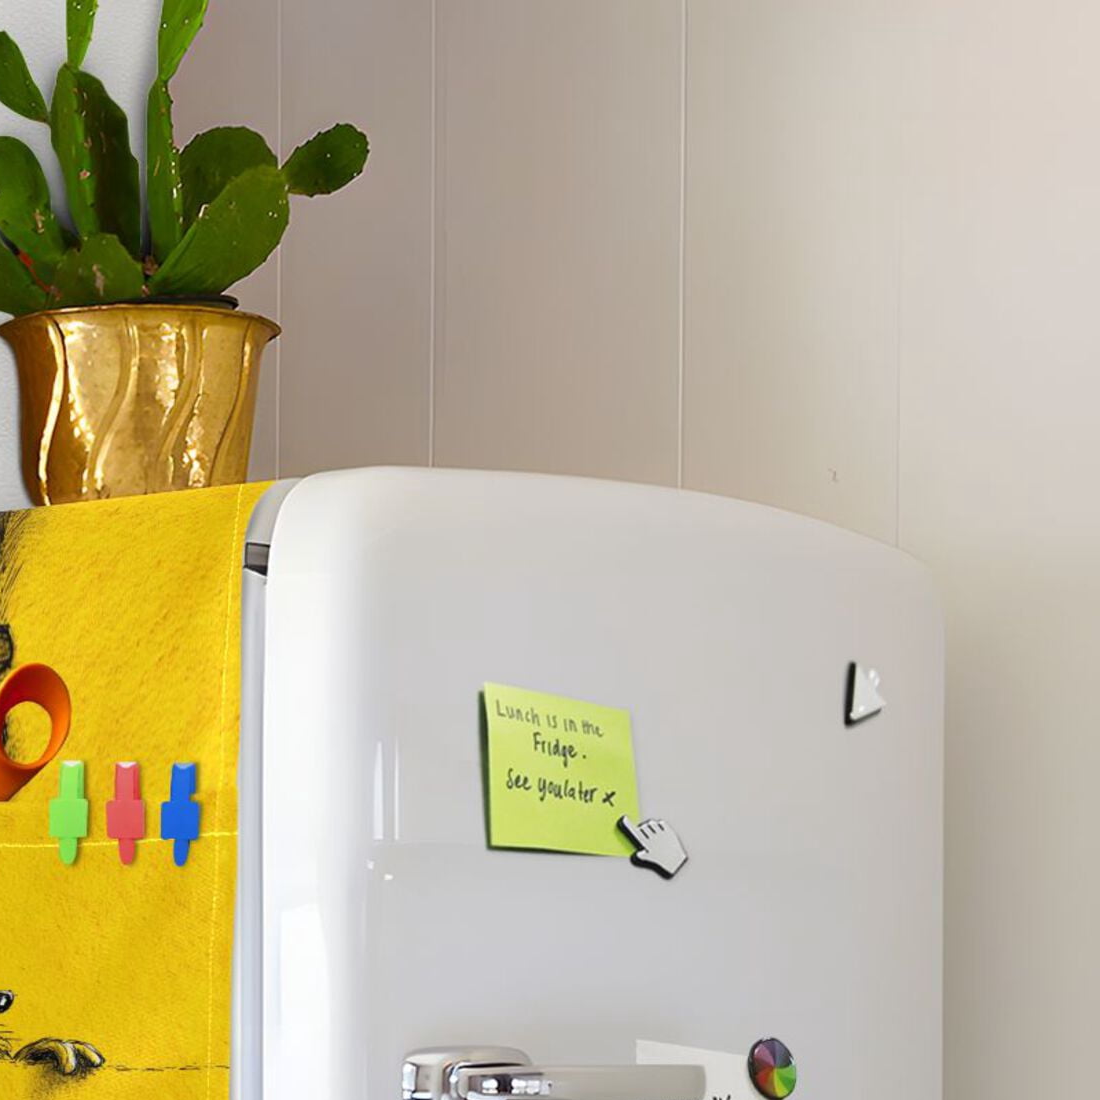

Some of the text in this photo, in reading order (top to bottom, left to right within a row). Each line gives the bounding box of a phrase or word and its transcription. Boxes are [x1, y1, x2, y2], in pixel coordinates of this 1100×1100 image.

[496, 700, 540, 727] Lunch
[564, 719, 578, 733] in
[582, 719, 604, 738] the
[506, 768, 531, 789] See
